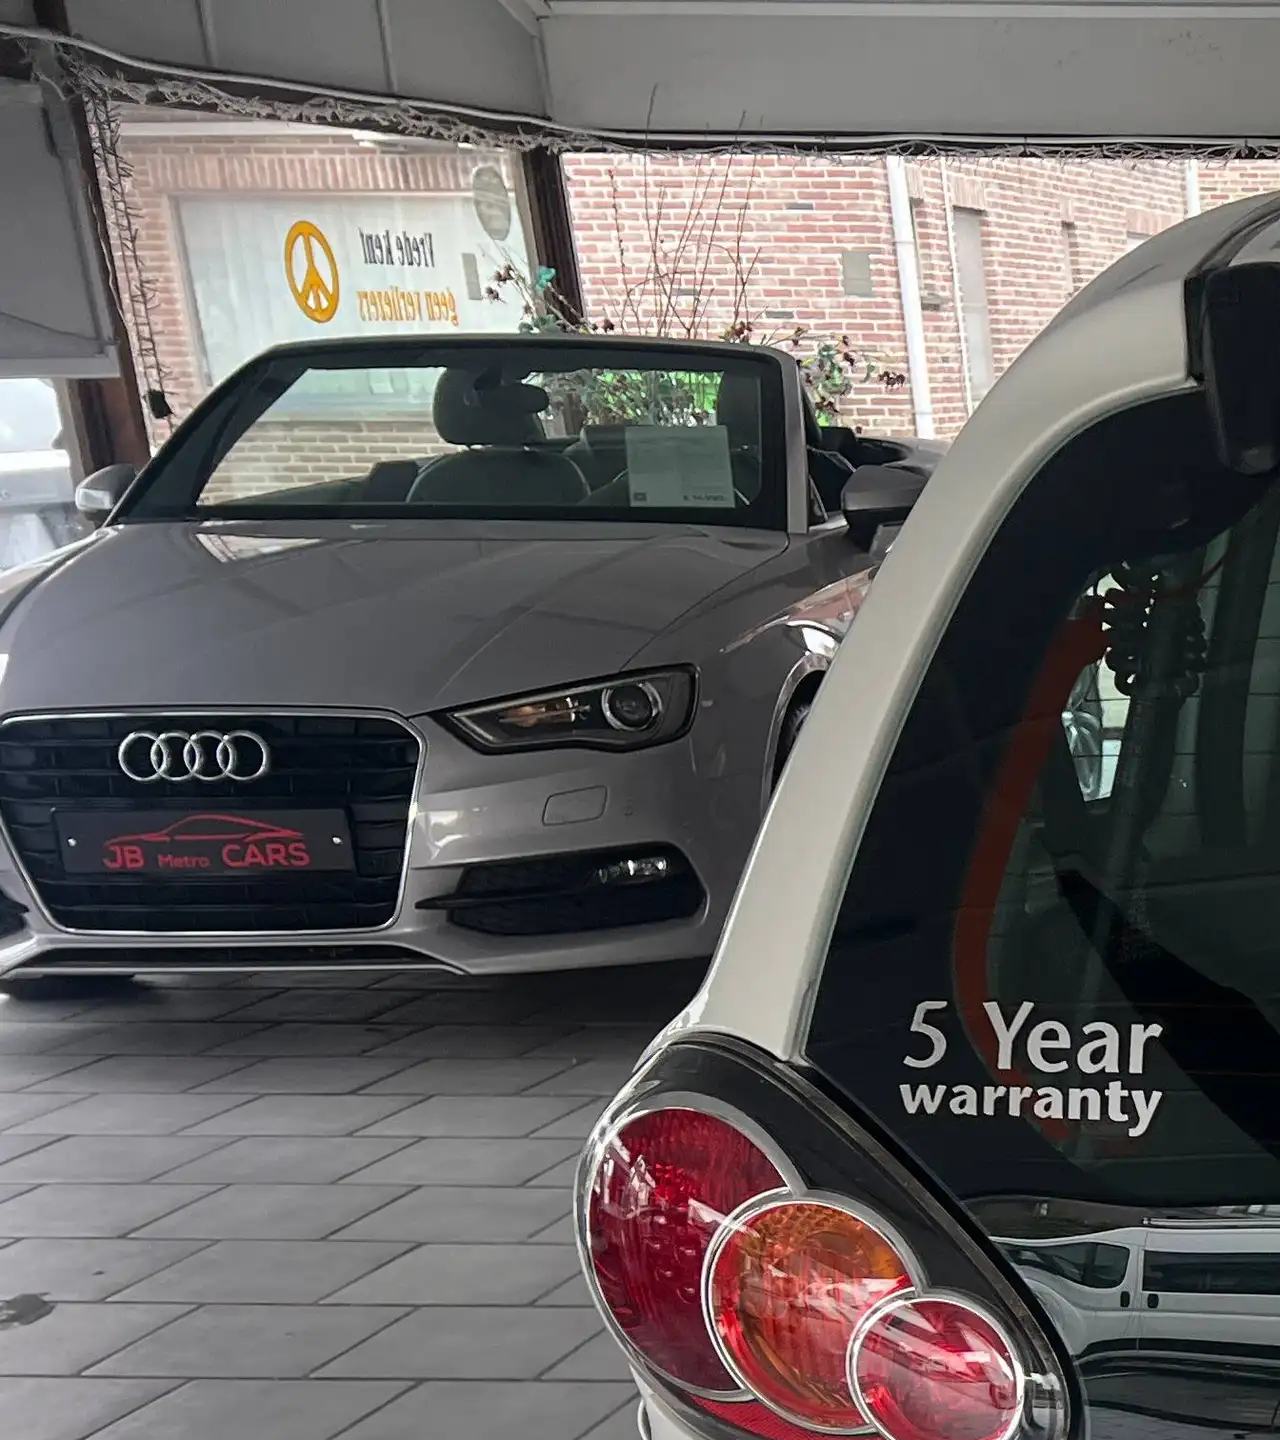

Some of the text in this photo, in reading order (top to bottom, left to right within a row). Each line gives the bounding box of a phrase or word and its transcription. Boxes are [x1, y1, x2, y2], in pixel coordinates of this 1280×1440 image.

[103, 843, 311, 870] JB Metro CARS
[903, 1001, 1163, 1075] 5 Year
[899, 1081, 1163, 1138] warranty
